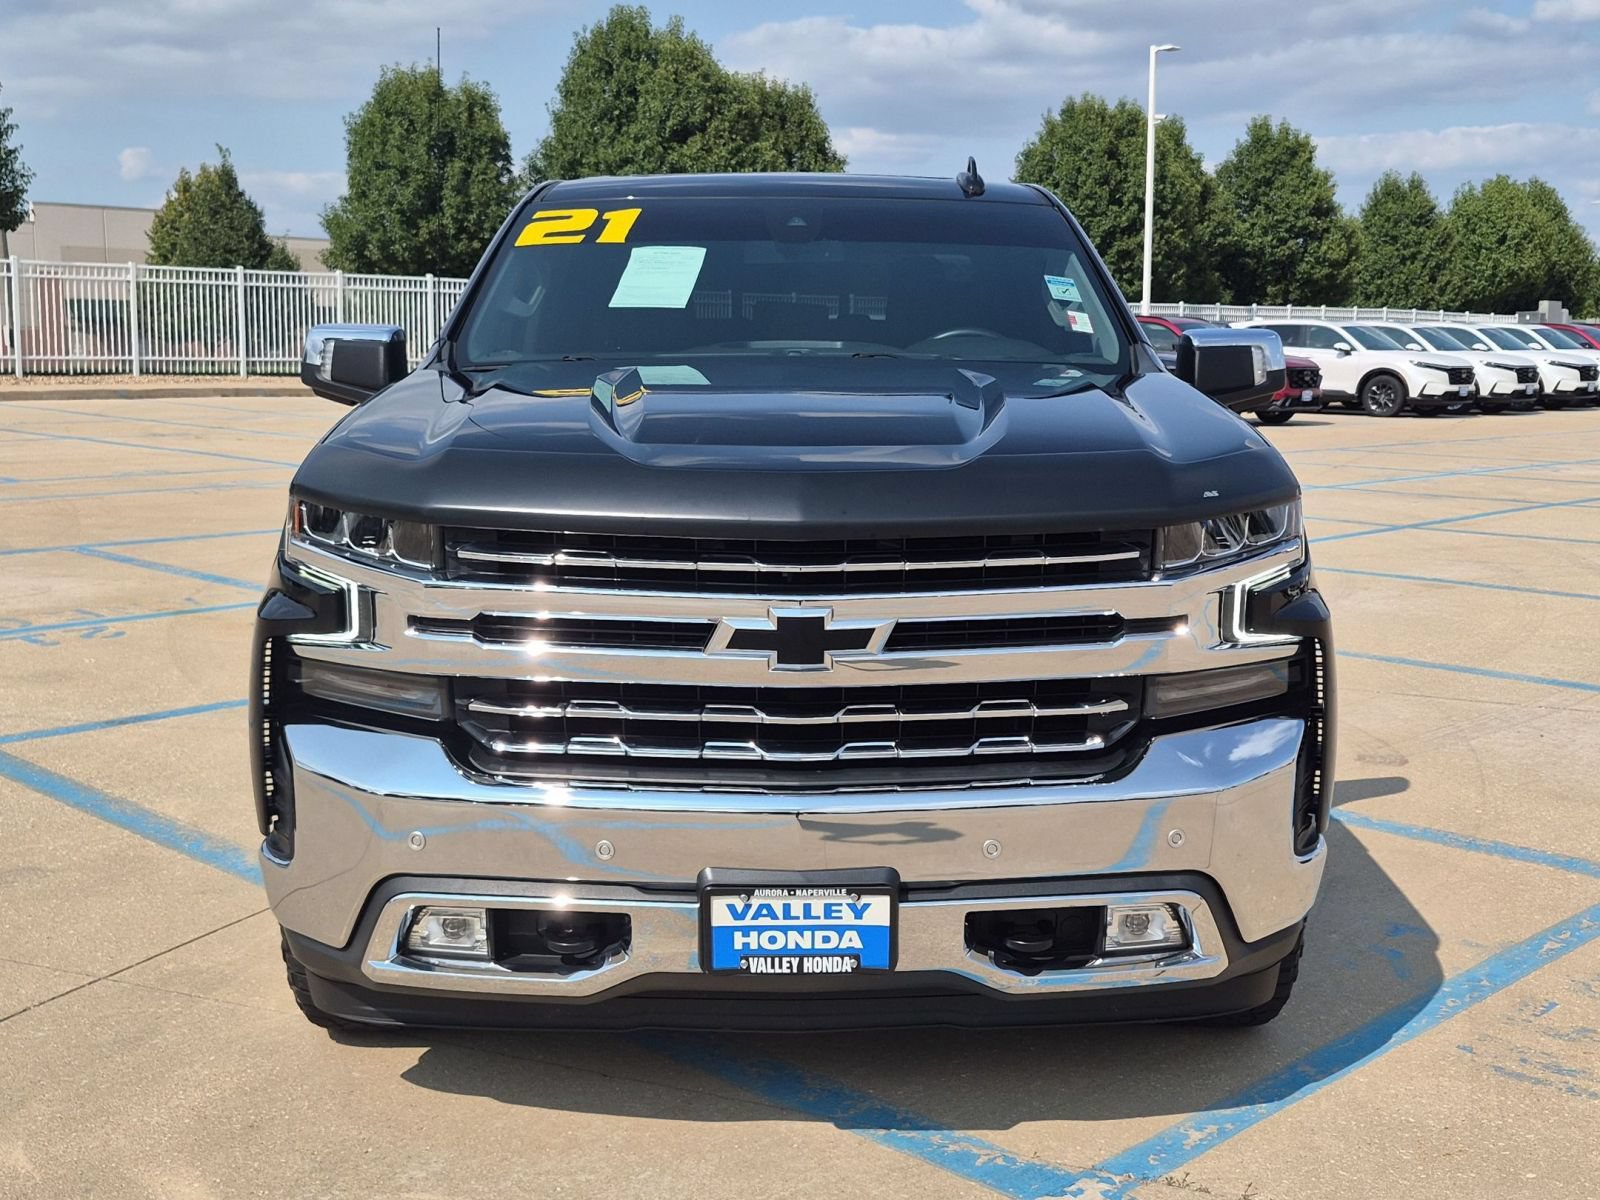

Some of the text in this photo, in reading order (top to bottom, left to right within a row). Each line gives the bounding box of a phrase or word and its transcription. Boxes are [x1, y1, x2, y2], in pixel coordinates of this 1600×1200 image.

[515, 208, 642, 247] 21
[753, 888, 847, 897] AURORA NAPERVILLE
[726, 903, 872, 921] VALLEY
[733, 930, 863, 950] HONDA
[749, 956, 852, 974] VALLEY HONDA
